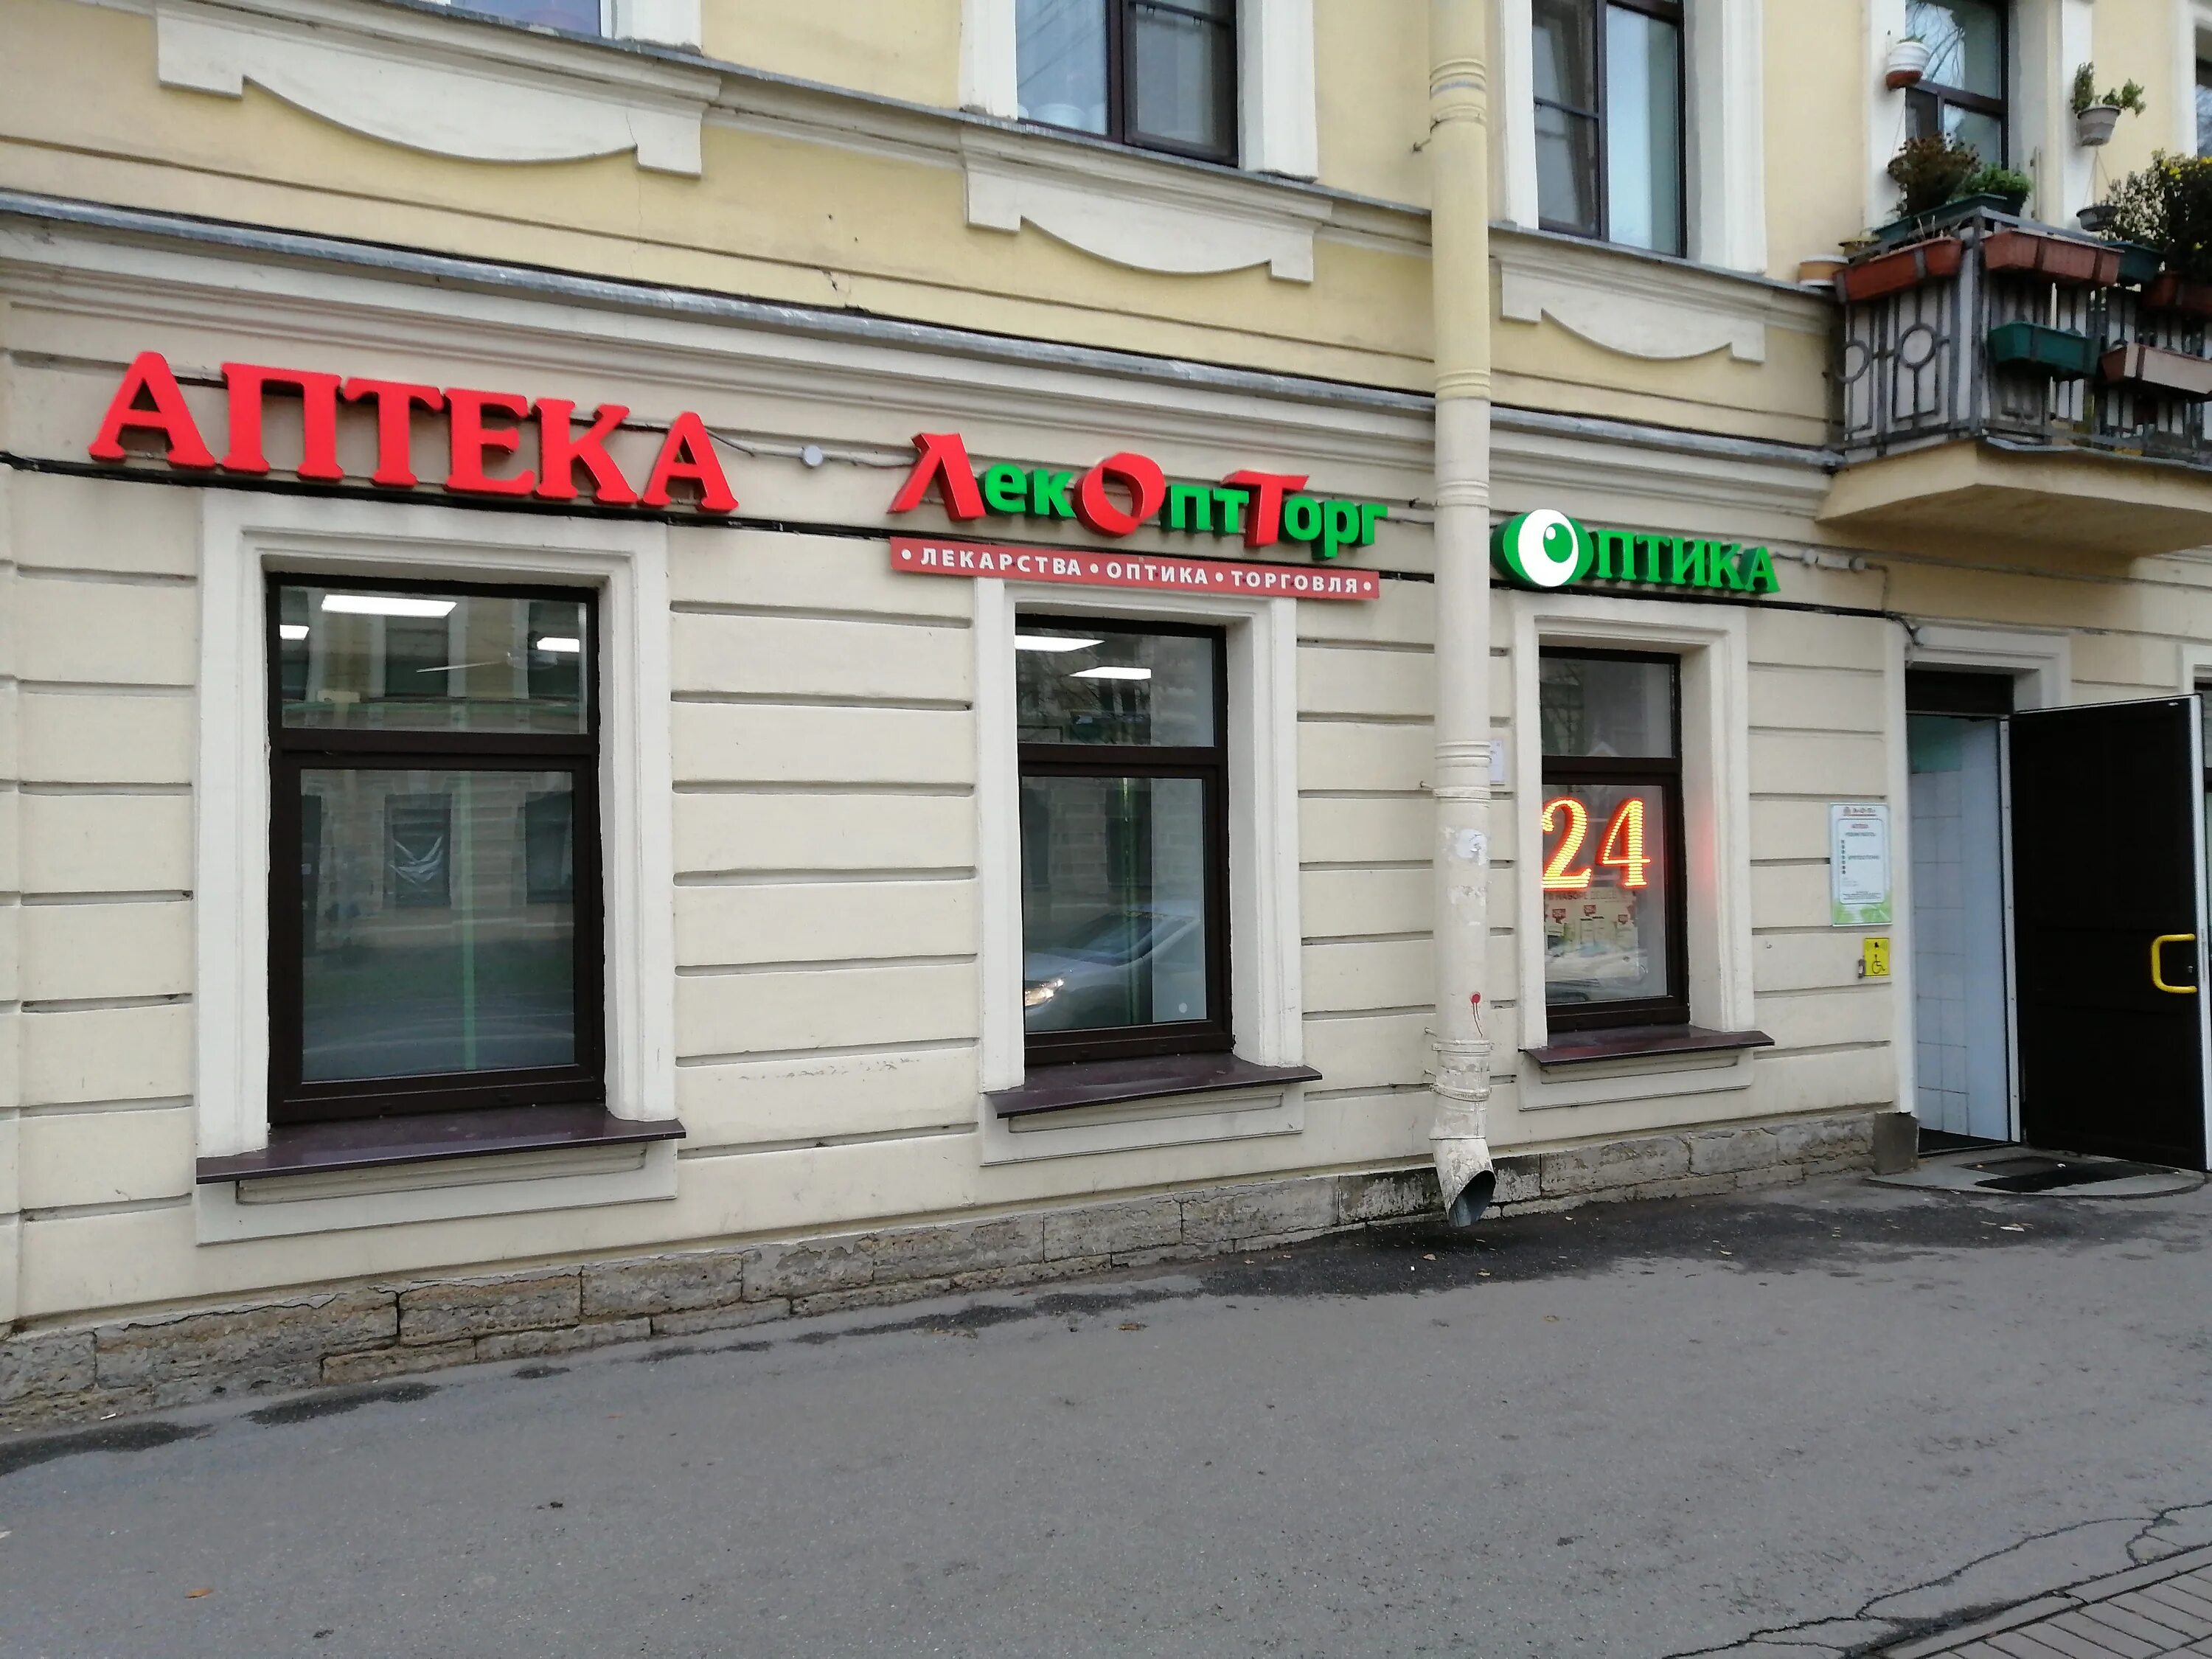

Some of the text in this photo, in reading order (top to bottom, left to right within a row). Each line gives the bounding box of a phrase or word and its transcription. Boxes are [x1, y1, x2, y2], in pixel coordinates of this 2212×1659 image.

[88, 351, 739, 513] АПТЕКА
[888, 432, 1388, 560] ЛекОптТорг
[920, 547, 1357, 594] ЛЕКАРСТВА ОПТИКА ТОРГОВЛЯ
[1540, 797, 1652, 891] 24
